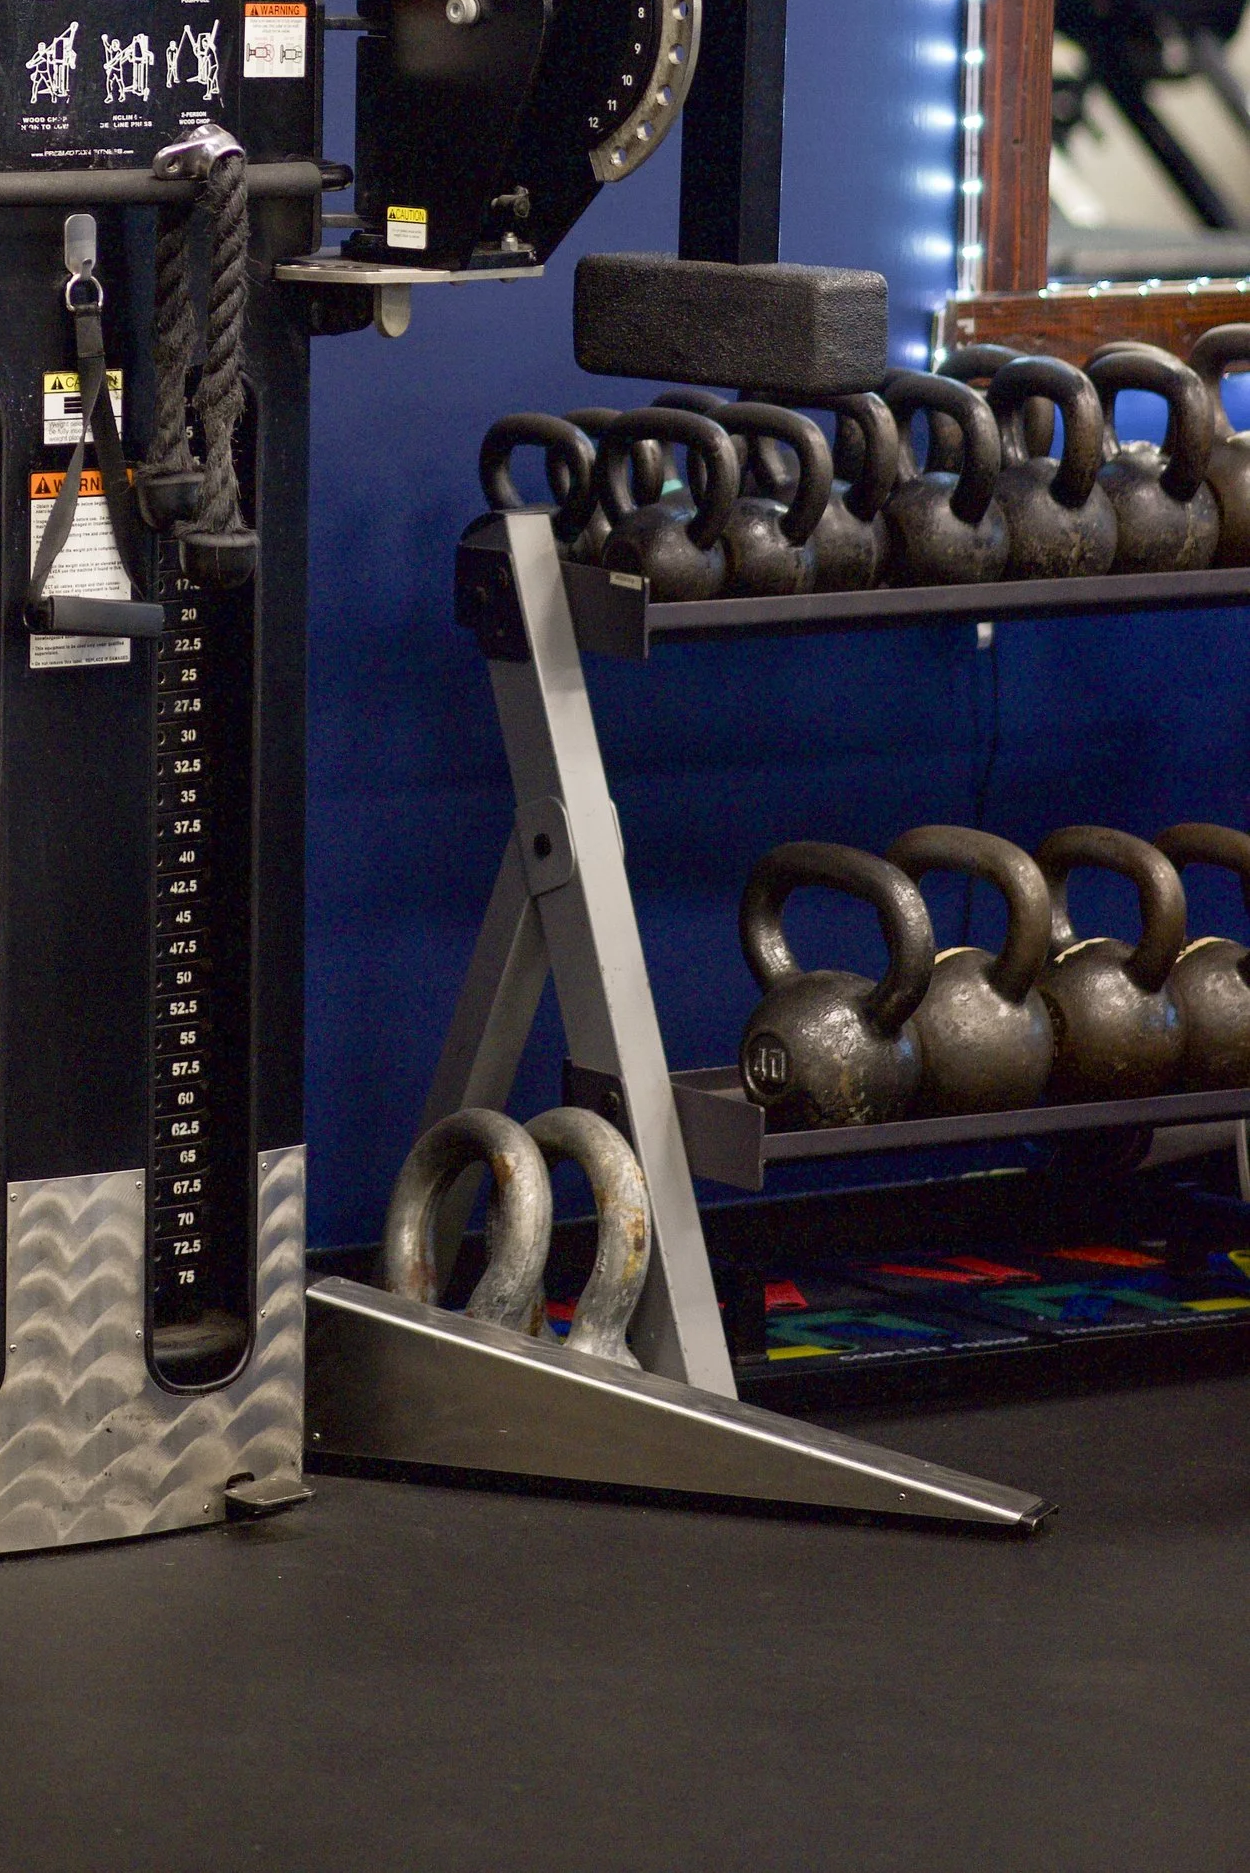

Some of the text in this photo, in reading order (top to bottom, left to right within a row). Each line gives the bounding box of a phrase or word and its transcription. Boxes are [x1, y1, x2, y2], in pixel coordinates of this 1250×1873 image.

[260, 6, 300, 16] WARNING
[638, 7, 645, 18] 8
[634, 43, 641, 54] 9
[622, 74, 632, 85] 10
[607, 99, 617, 111] 11
[588, 117, 598, 128] 12
[396, 209, 424, 221] CAUTION
[176, 579, 200, 590] 17.
[182, 608, 196, 621] 20
[175, 638, 201, 651] 22.5
[182, 669, 197, 681] 25
[175, 699, 201, 712] 27.5
[181, 729, 196, 742] 30
[175, 759, 200, 773] 32.5
[181, 790, 196, 802] 35
[174, 820, 201, 834] 37.5
[179, 851, 195, 863] 40
[170, 880, 197, 893] 42.5
[176, 911, 191, 923] 45
[170, 940, 196, 954] 47.5
[177, 971, 191, 984] 50
[170, 1000, 197, 1015] 52.5
[180, 1031, 196, 1044] 55
[172, 1061, 199, 1076] 57.5
[178, 1092, 194, 1105] 60
[172, 1121, 199, 1136] 62.5
[180, 1150, 196, 1163] 65
[173, 1179, 201, 1194] 67.5
[178, 1212, 194, 1226] 70
[174, 1240, 200, 1255] 72.5
[179, 1270, 194, 1284] 75
